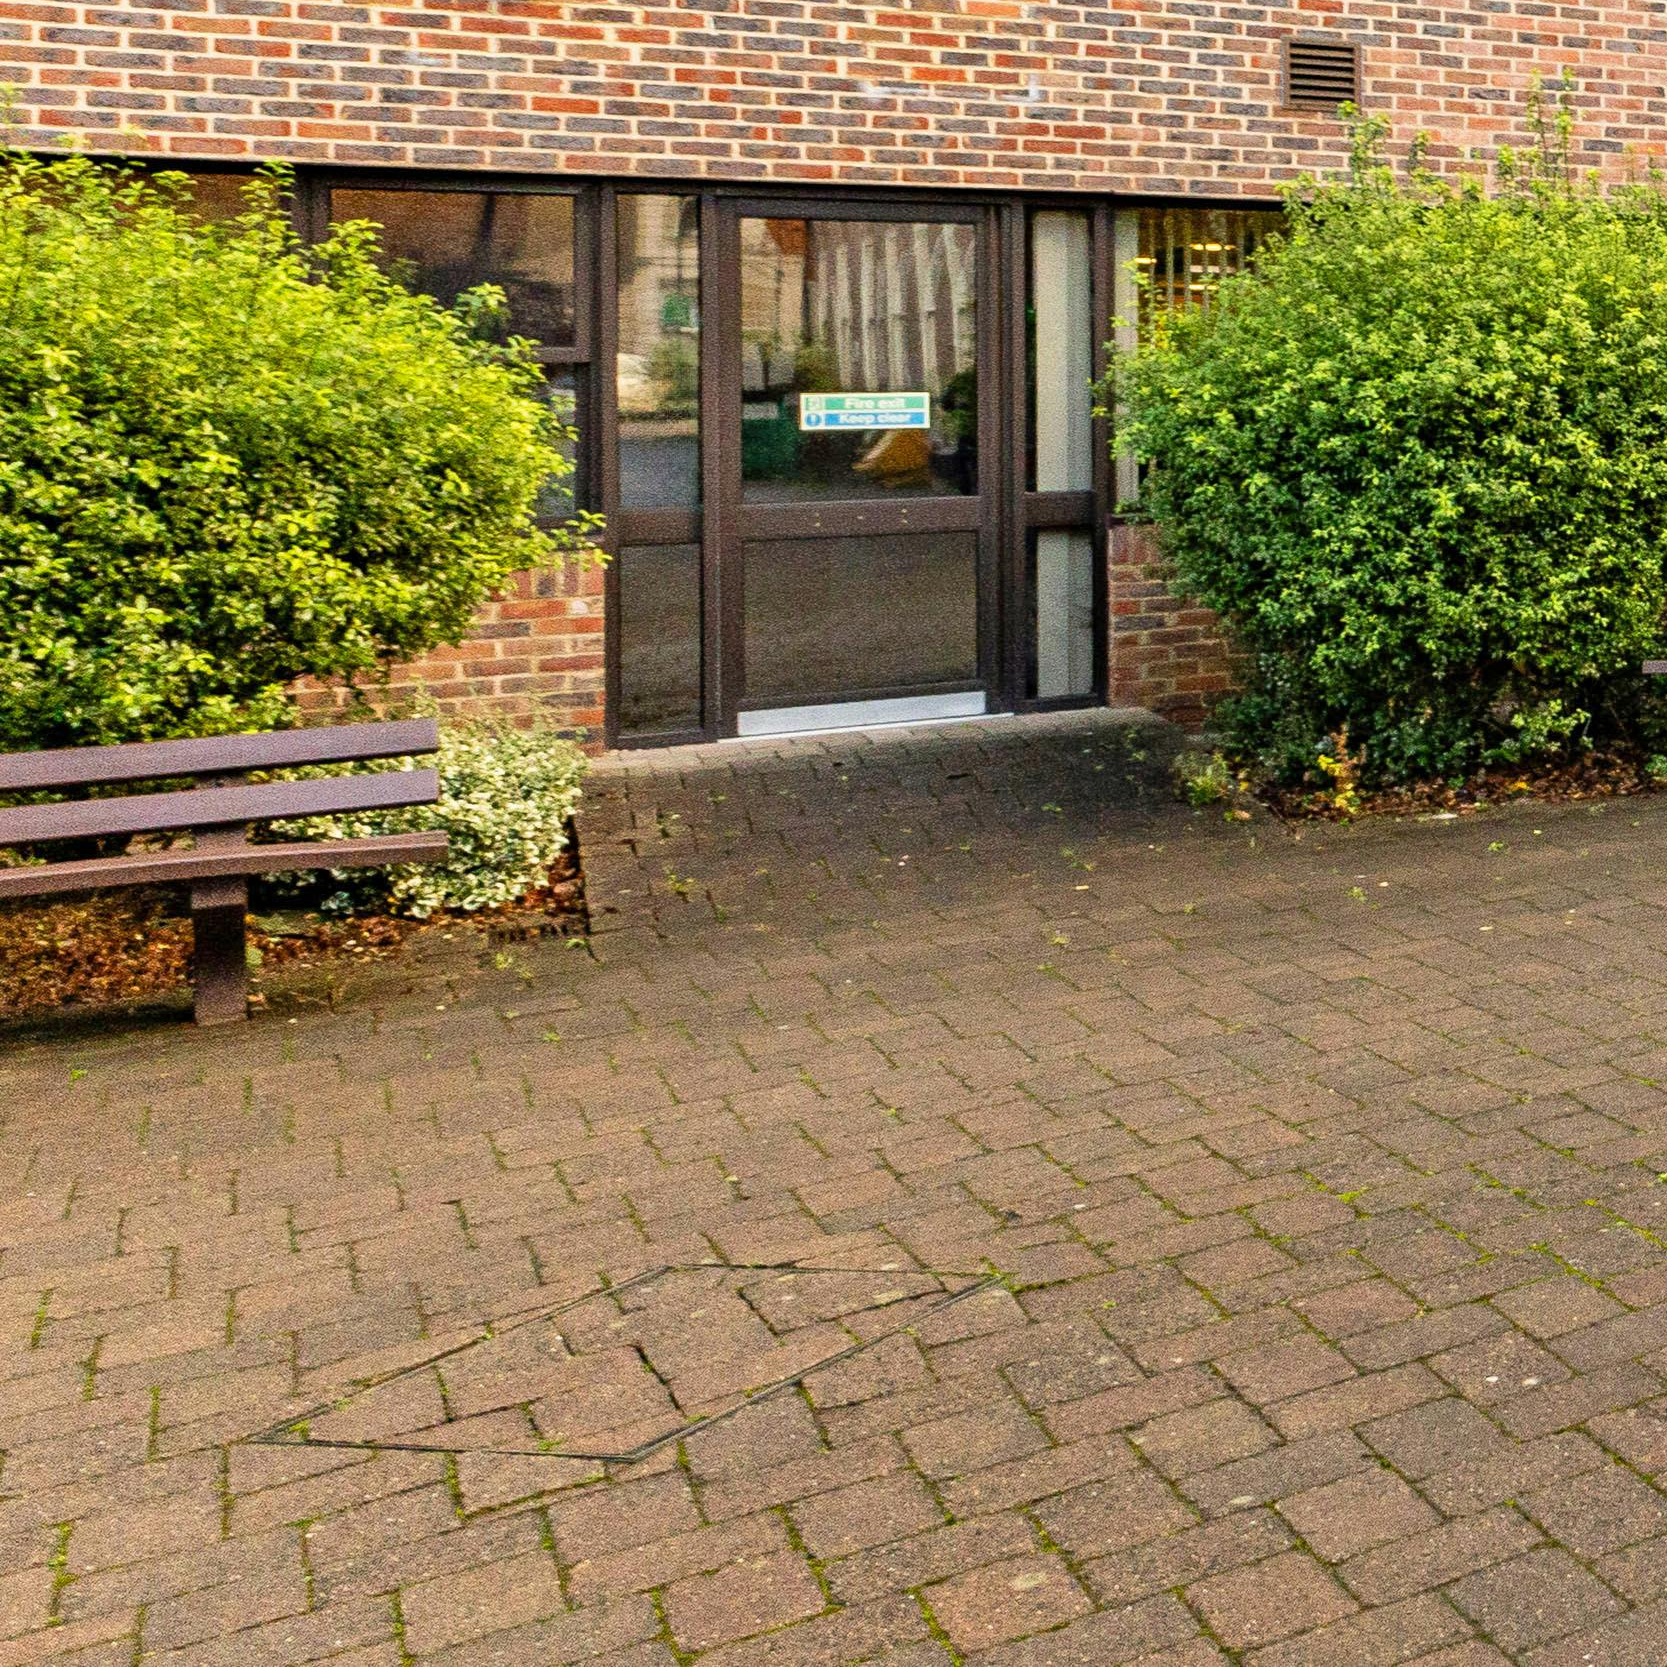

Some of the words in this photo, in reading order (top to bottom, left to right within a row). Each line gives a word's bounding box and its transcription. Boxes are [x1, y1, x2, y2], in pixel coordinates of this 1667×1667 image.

[844, 399, 874, 409] Fire
[877, 398, 905, 409] exit
[838, 414, 874, 425] Keep
[877, 414, 911, 424] clear
